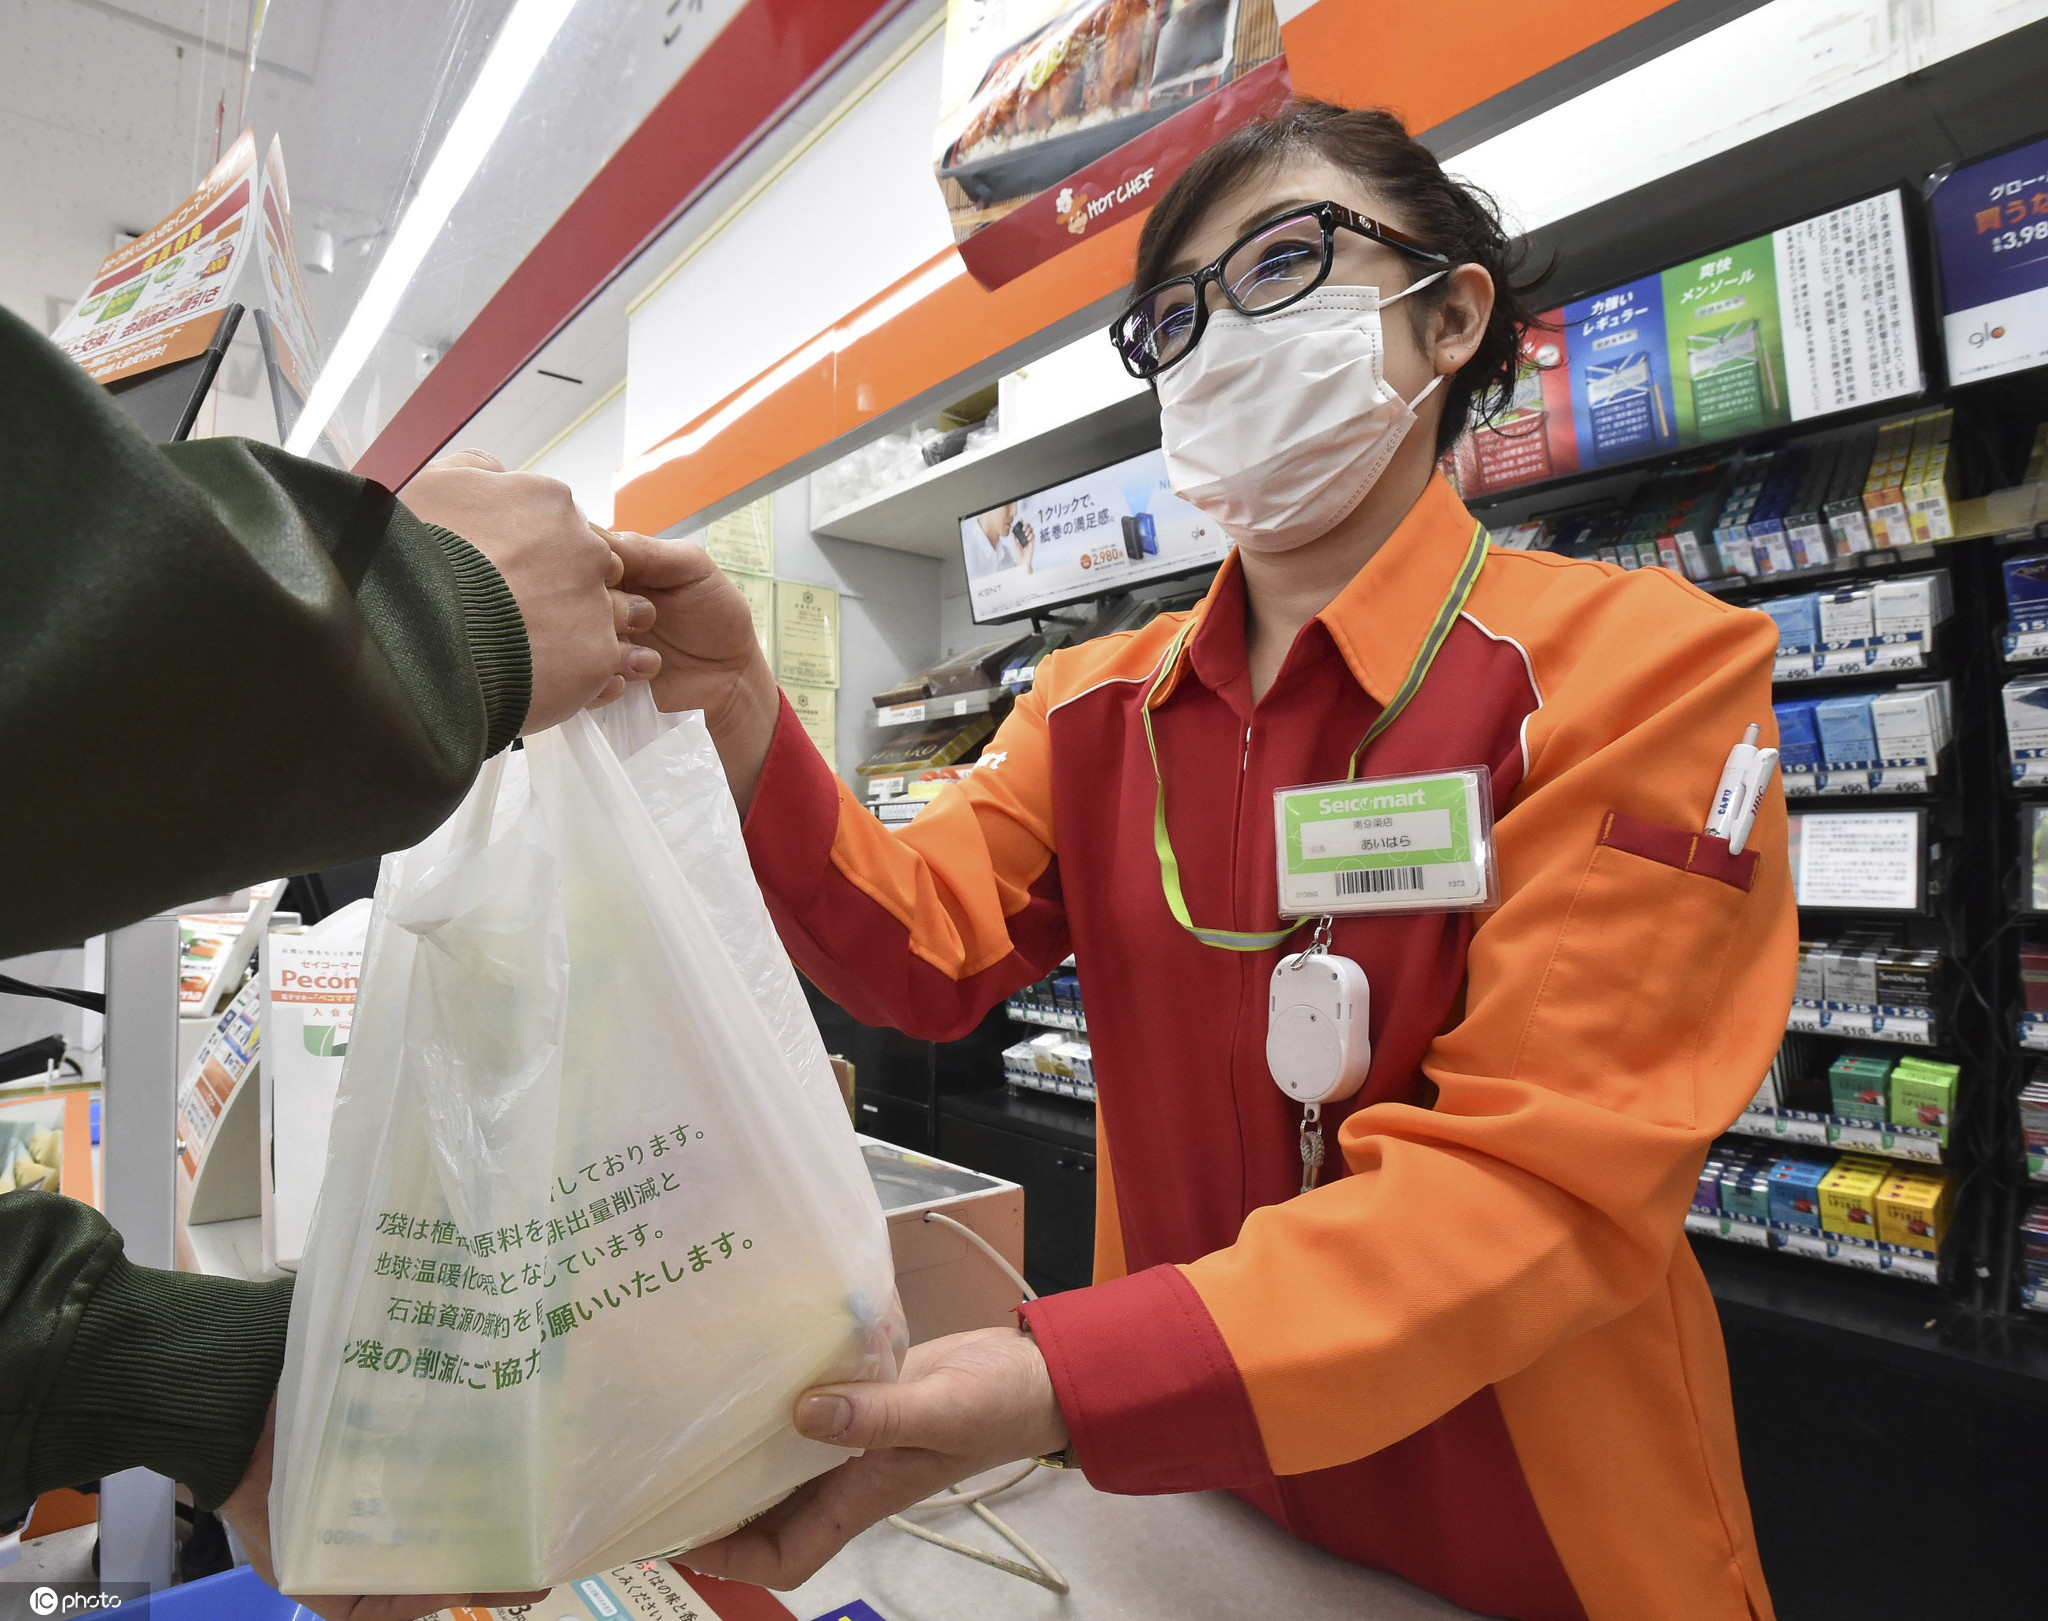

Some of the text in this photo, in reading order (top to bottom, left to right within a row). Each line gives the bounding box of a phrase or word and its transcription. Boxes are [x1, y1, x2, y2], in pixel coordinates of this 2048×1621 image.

[1086, 167, 1155, 219] HOT CHEF
[1989, 171, 2048, 202] グロー・
[1699, 256, 1733, 280] 爽快
[1680, 269, 1756, 304] メンソール
[1591, 291, 1634, 316] 力強い
[1583, 307, 1649, 337] レギュラー
[1968, 322, 2006, 351] glo
[1037, 493, 1097, 523] 1クリックで、
[1039, 508, 1116, 544] 紙巻の満足感。
[978, 584, 1002, 598] KENT
[1838, 662, 1861, 674] 490
[1890, 656, 1914, 668] 490
[1827, 761, 1858, 771] 111
[1882, 758, 1917, 768] 112
[1319, 787, 1426, 816] Seicomart
[1360, 834, 1411, 852] あいはら
[550, 1123, 706, 1203] しております。
[540, 1230, 754, 1344] 願いいたします。
